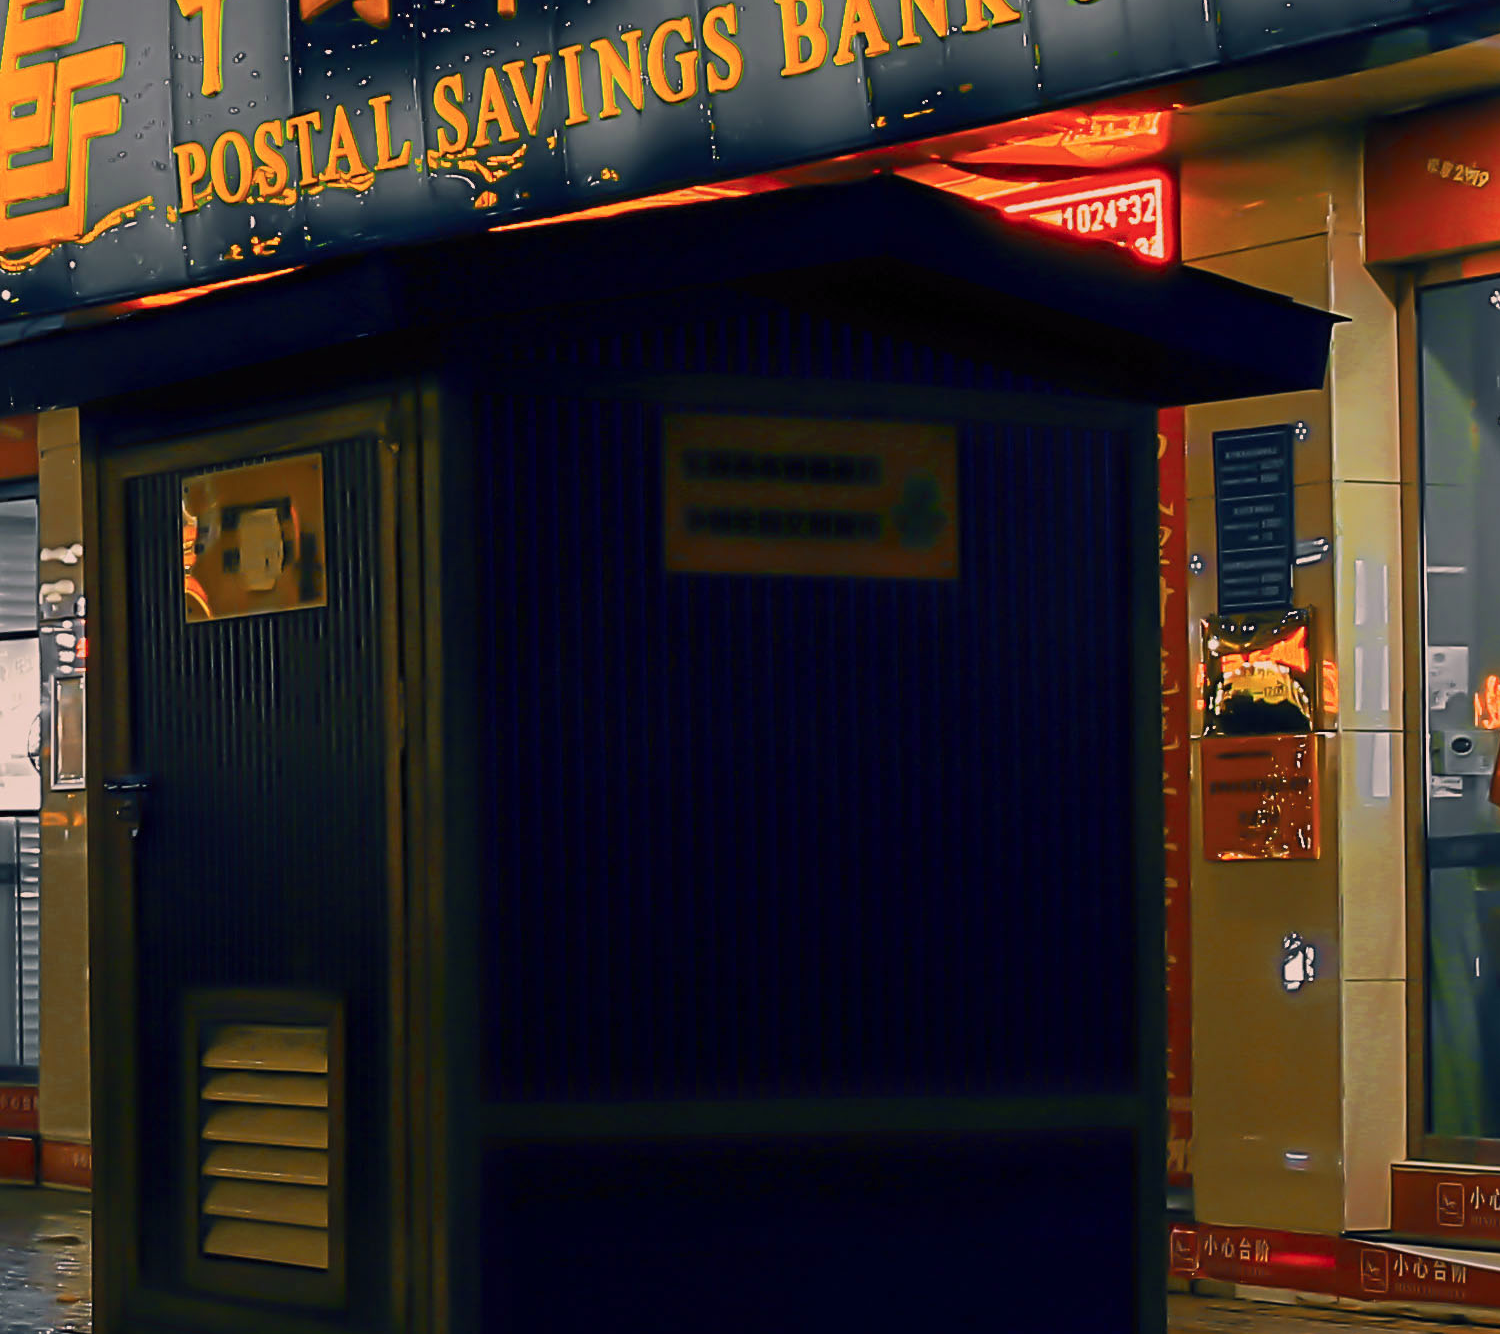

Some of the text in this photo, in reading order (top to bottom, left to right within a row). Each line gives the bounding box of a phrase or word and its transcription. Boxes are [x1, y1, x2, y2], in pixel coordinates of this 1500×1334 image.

[173, 95, 411, 214] POSTAL
[433, 2, 742, 155] SAVINGS
[1204, 1234, 1270, 1263] 小心台阶
